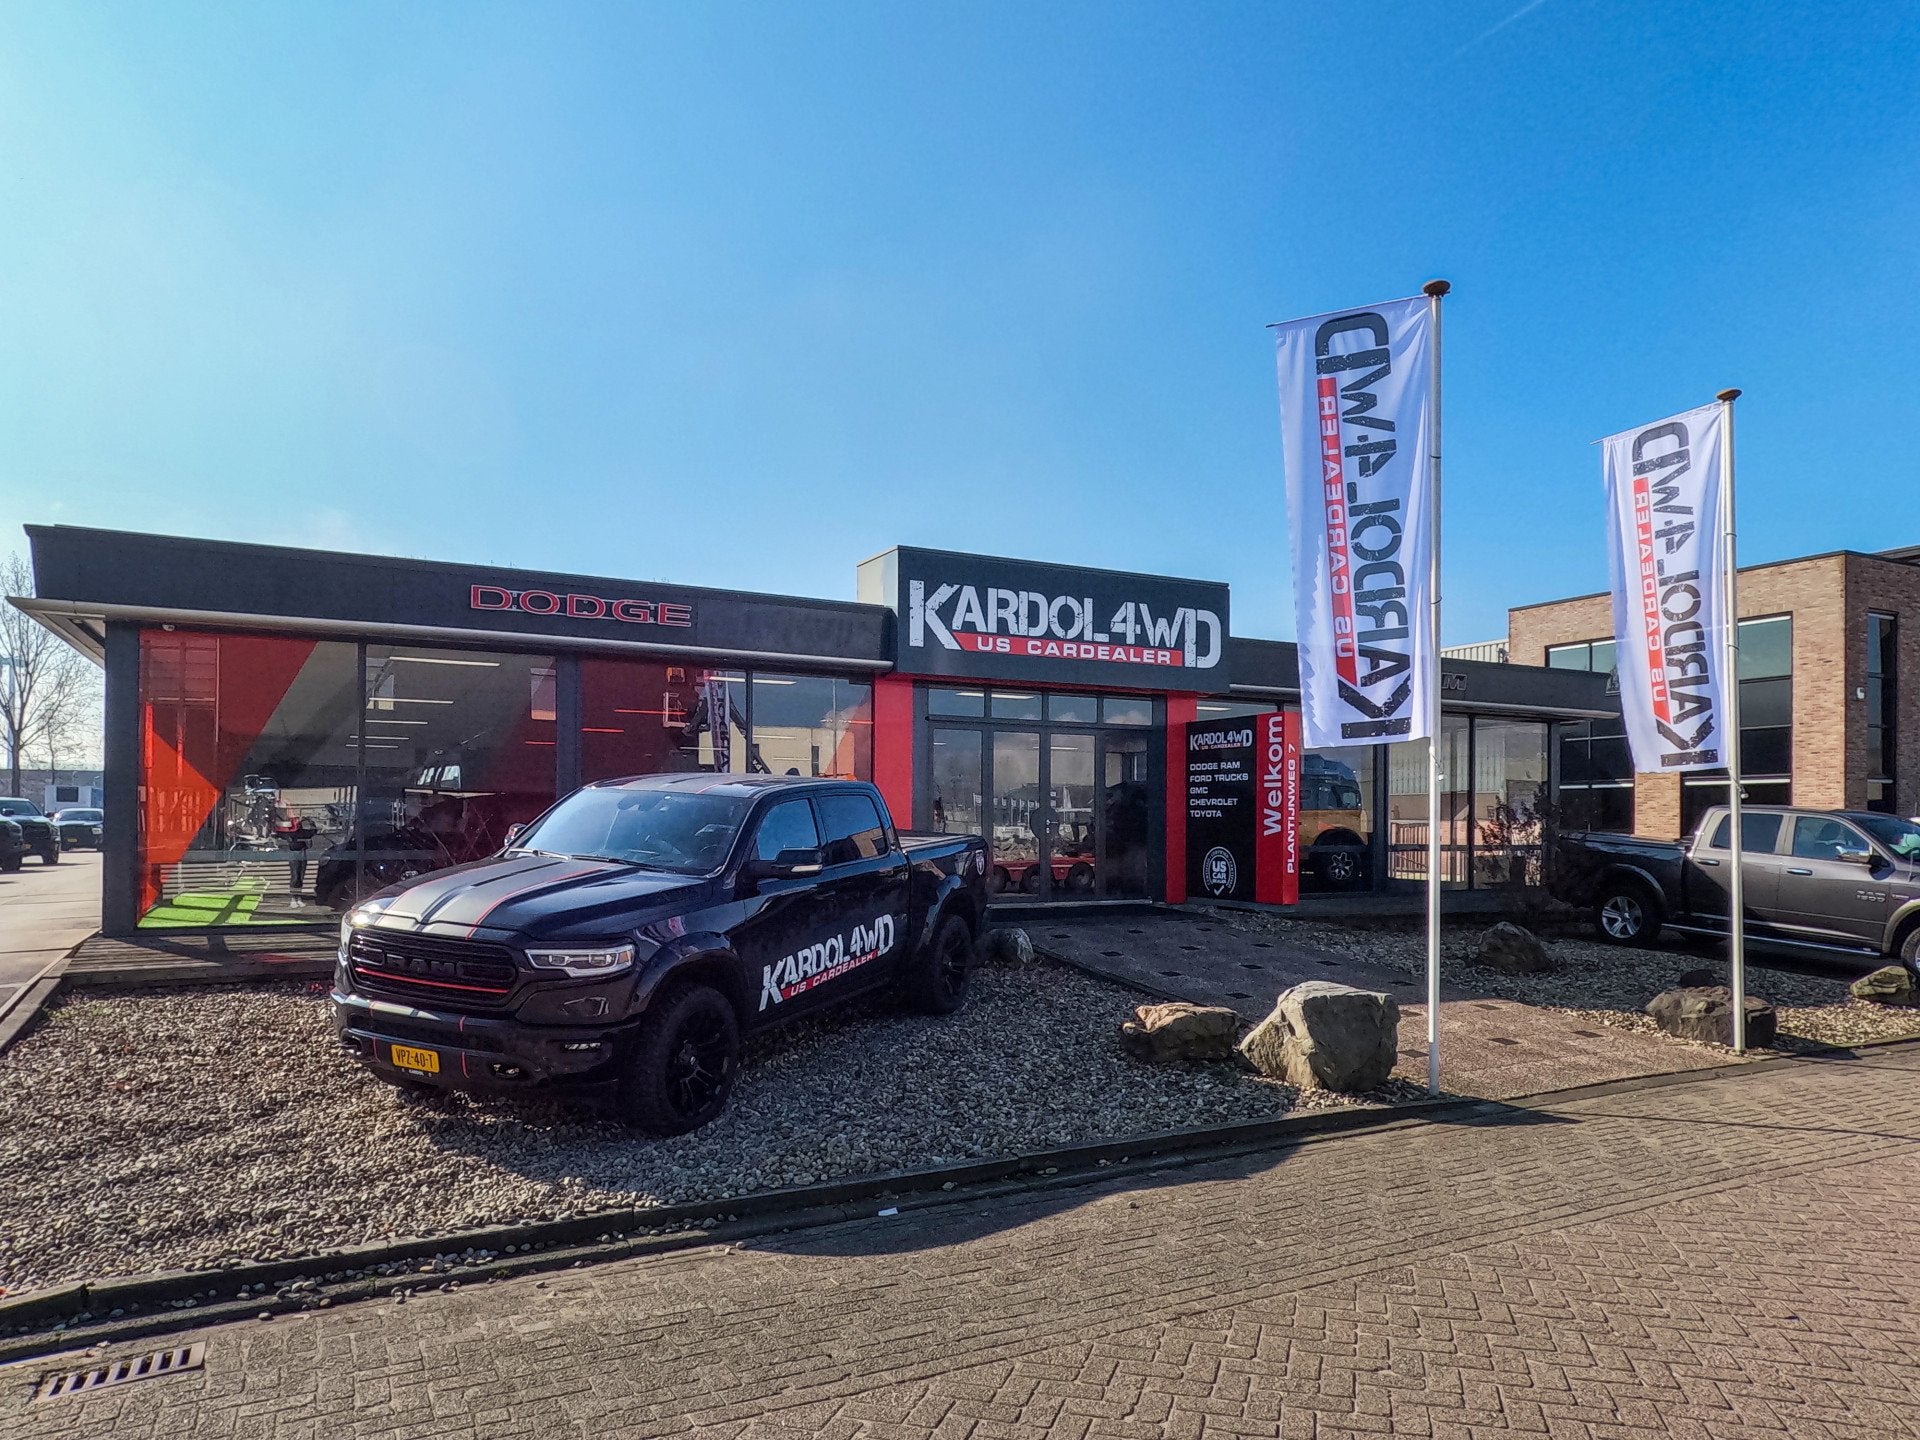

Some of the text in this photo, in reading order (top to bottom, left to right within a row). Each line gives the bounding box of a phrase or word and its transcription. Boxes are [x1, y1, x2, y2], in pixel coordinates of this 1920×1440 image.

[470, 584, 692, 628] DODGE
[977, 635, 1172, 664] US CARDEALER
[1189, 761, 1241, 771] DODGE RAM
[1189, 773, 1249, 783] FORD TRUCKS
[1263, 716, 1283, 836] Welkom
[1189, 798, 1239, 806] CHEVROLET
[1287, 743, 1296, 874] PLANTIJNWEG 7
[1189, 810, 1223, 818] TOYOTA
[1212, 861, 1227, 872] US
[1212, 872, 1227, 880] CAR
[790, 951, 874, 997] US CARDEALER
[395, 1047, 433, 1069] VPZ-40-T
